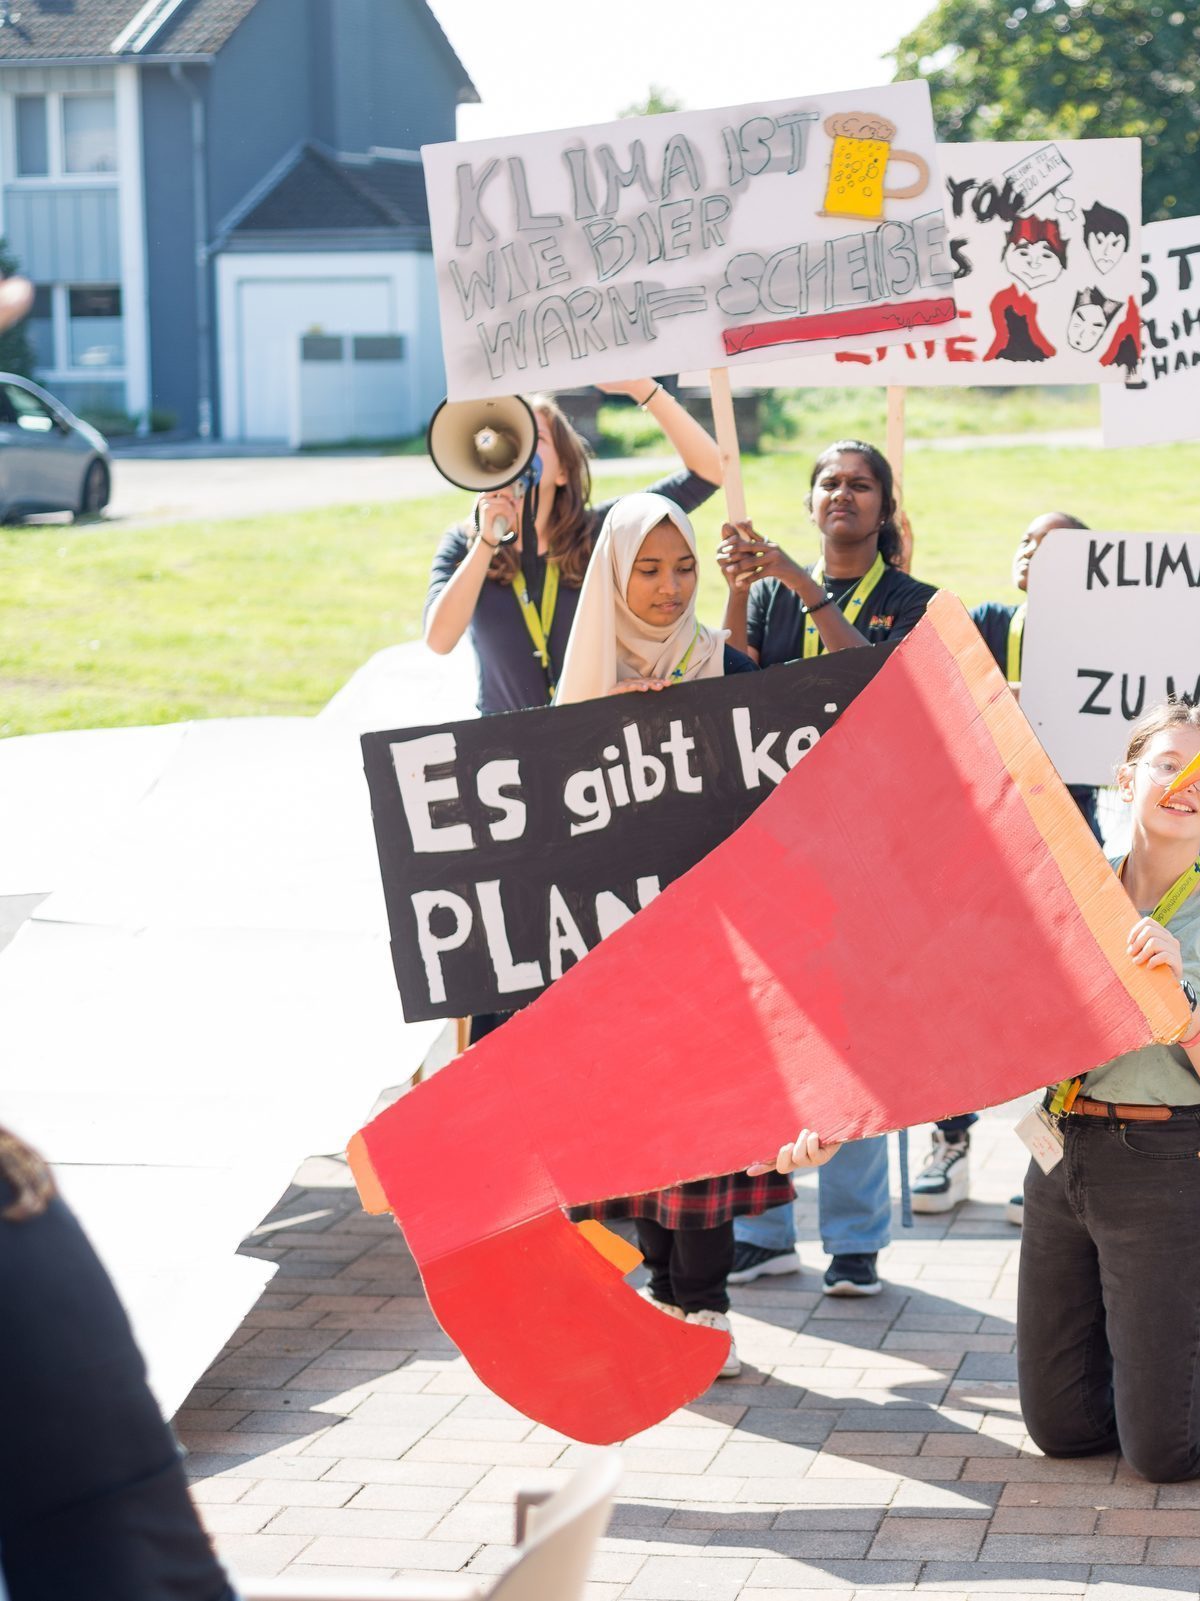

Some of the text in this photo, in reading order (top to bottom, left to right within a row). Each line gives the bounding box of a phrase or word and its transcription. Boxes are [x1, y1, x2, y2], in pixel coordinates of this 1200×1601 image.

[455, 111, 819, 247] KLIMA IST
[449, 194, 733, 321] WIE BIER
[1076, 668, 1146, 721] ZU
[389, 732, 528, 853] Es
[563, 719, 703, 837] gibt
